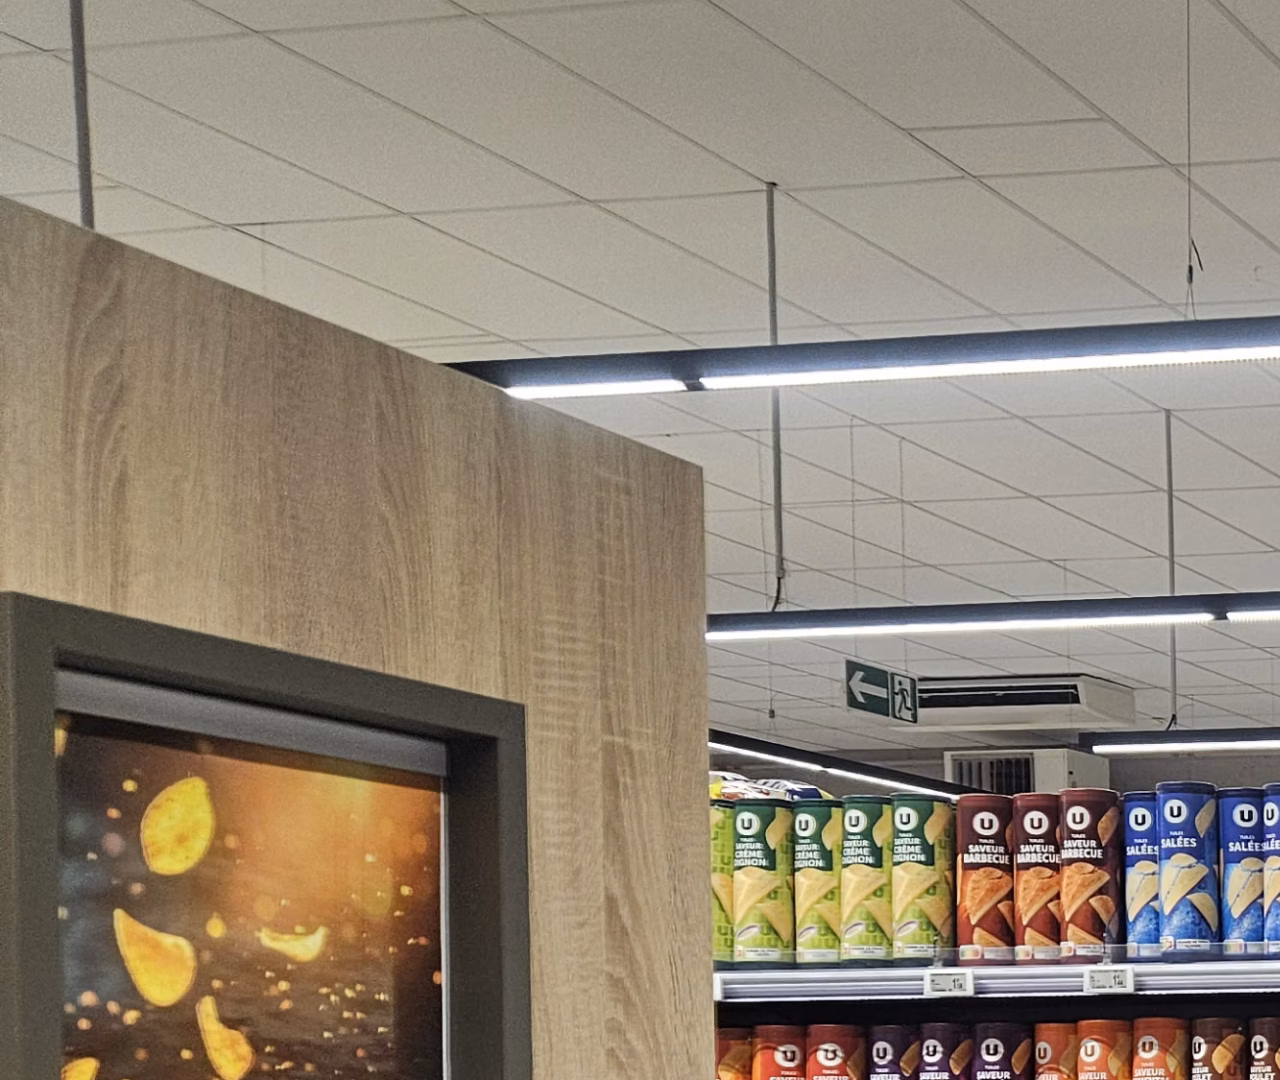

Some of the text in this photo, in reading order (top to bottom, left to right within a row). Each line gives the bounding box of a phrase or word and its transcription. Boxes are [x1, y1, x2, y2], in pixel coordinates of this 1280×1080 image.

[1064, 839, 1097, 849] SAVEUR
[1161, 835, 1197, 849] SALÉES
[968, 844, 1005, 854] SAVEUR
[1019, 844, 1055, 854] SAVEUR
[1126, 843, 1159, 856] SALÉES
[963, 853, 1010, 865] BARBECUE
[1017, 853, 1061, 864] BARBECUE
[976, 1070, 1011, 1080] SAVEUR
